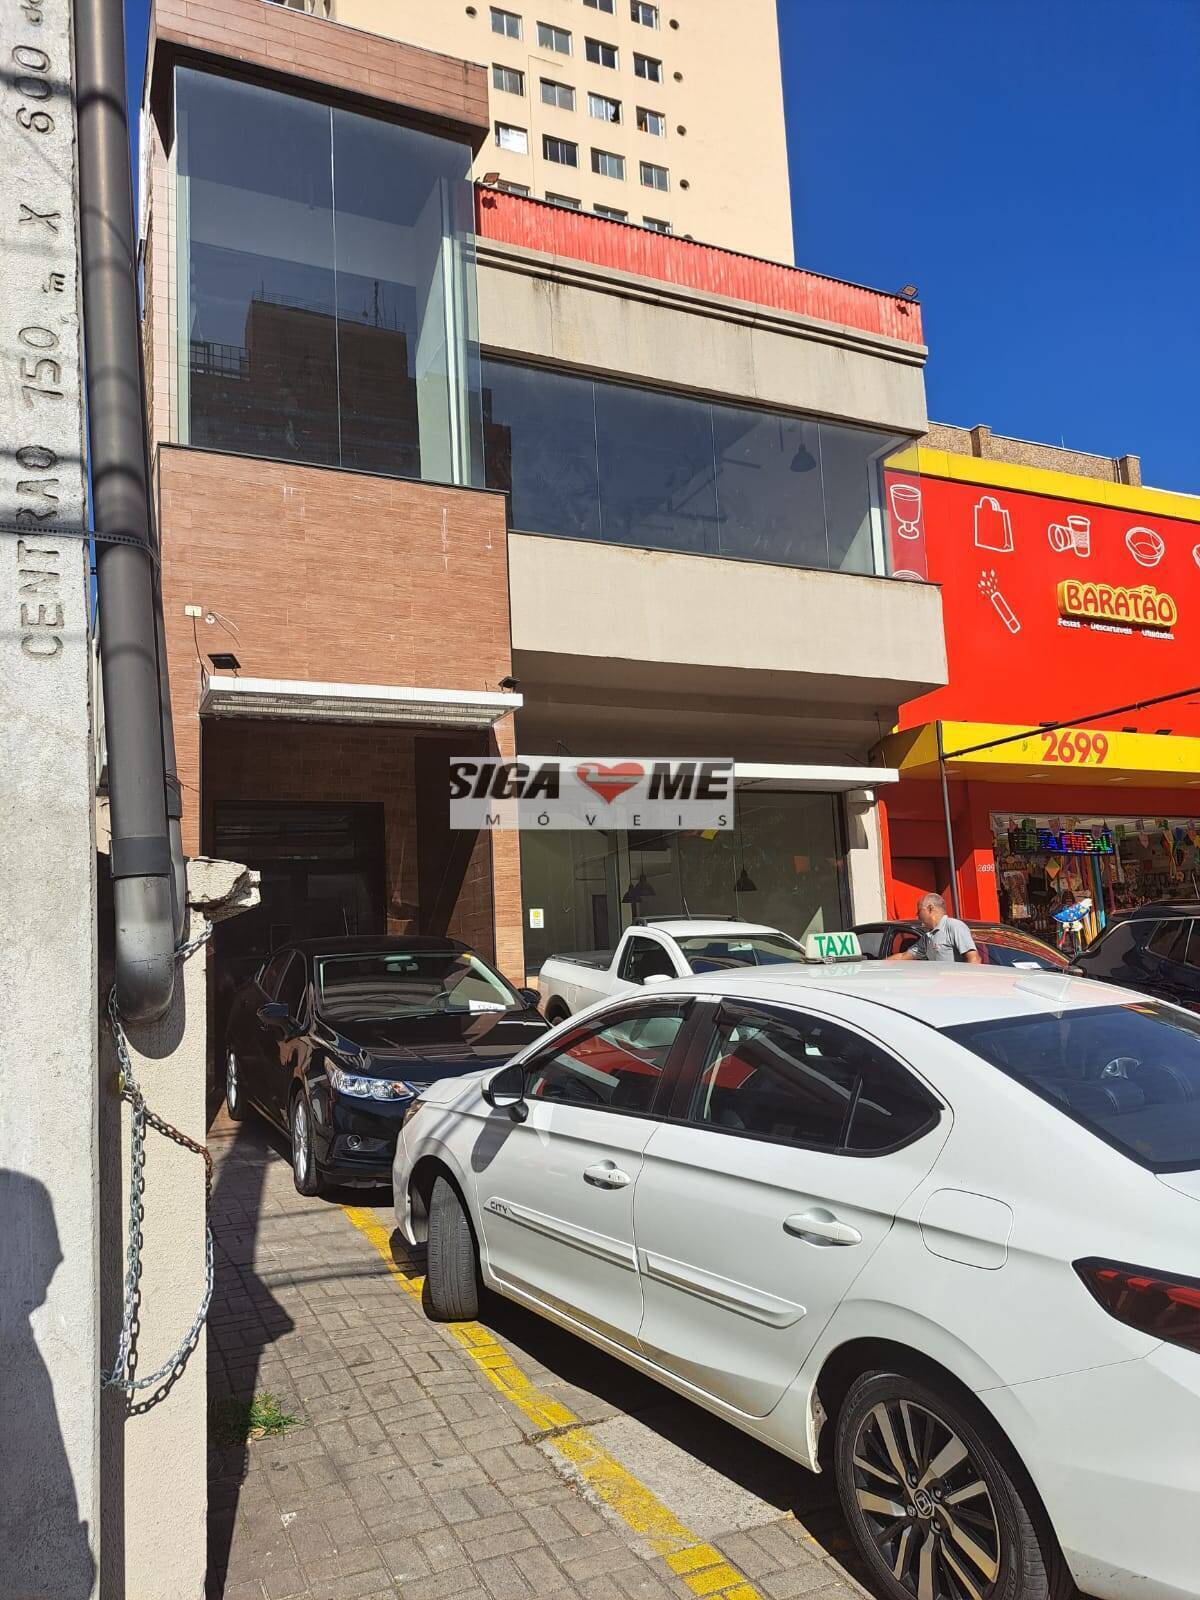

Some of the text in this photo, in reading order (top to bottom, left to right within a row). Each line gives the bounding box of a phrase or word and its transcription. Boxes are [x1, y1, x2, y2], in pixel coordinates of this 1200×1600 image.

[12, 45, 55, 134] 600
[1063, 582, 1175, 624] BARATÃO
[1041, 731, 1109, 764] 2699
[814, 934, 856, 957] TAXI
[490, 1201, 508, 1214] CITY
